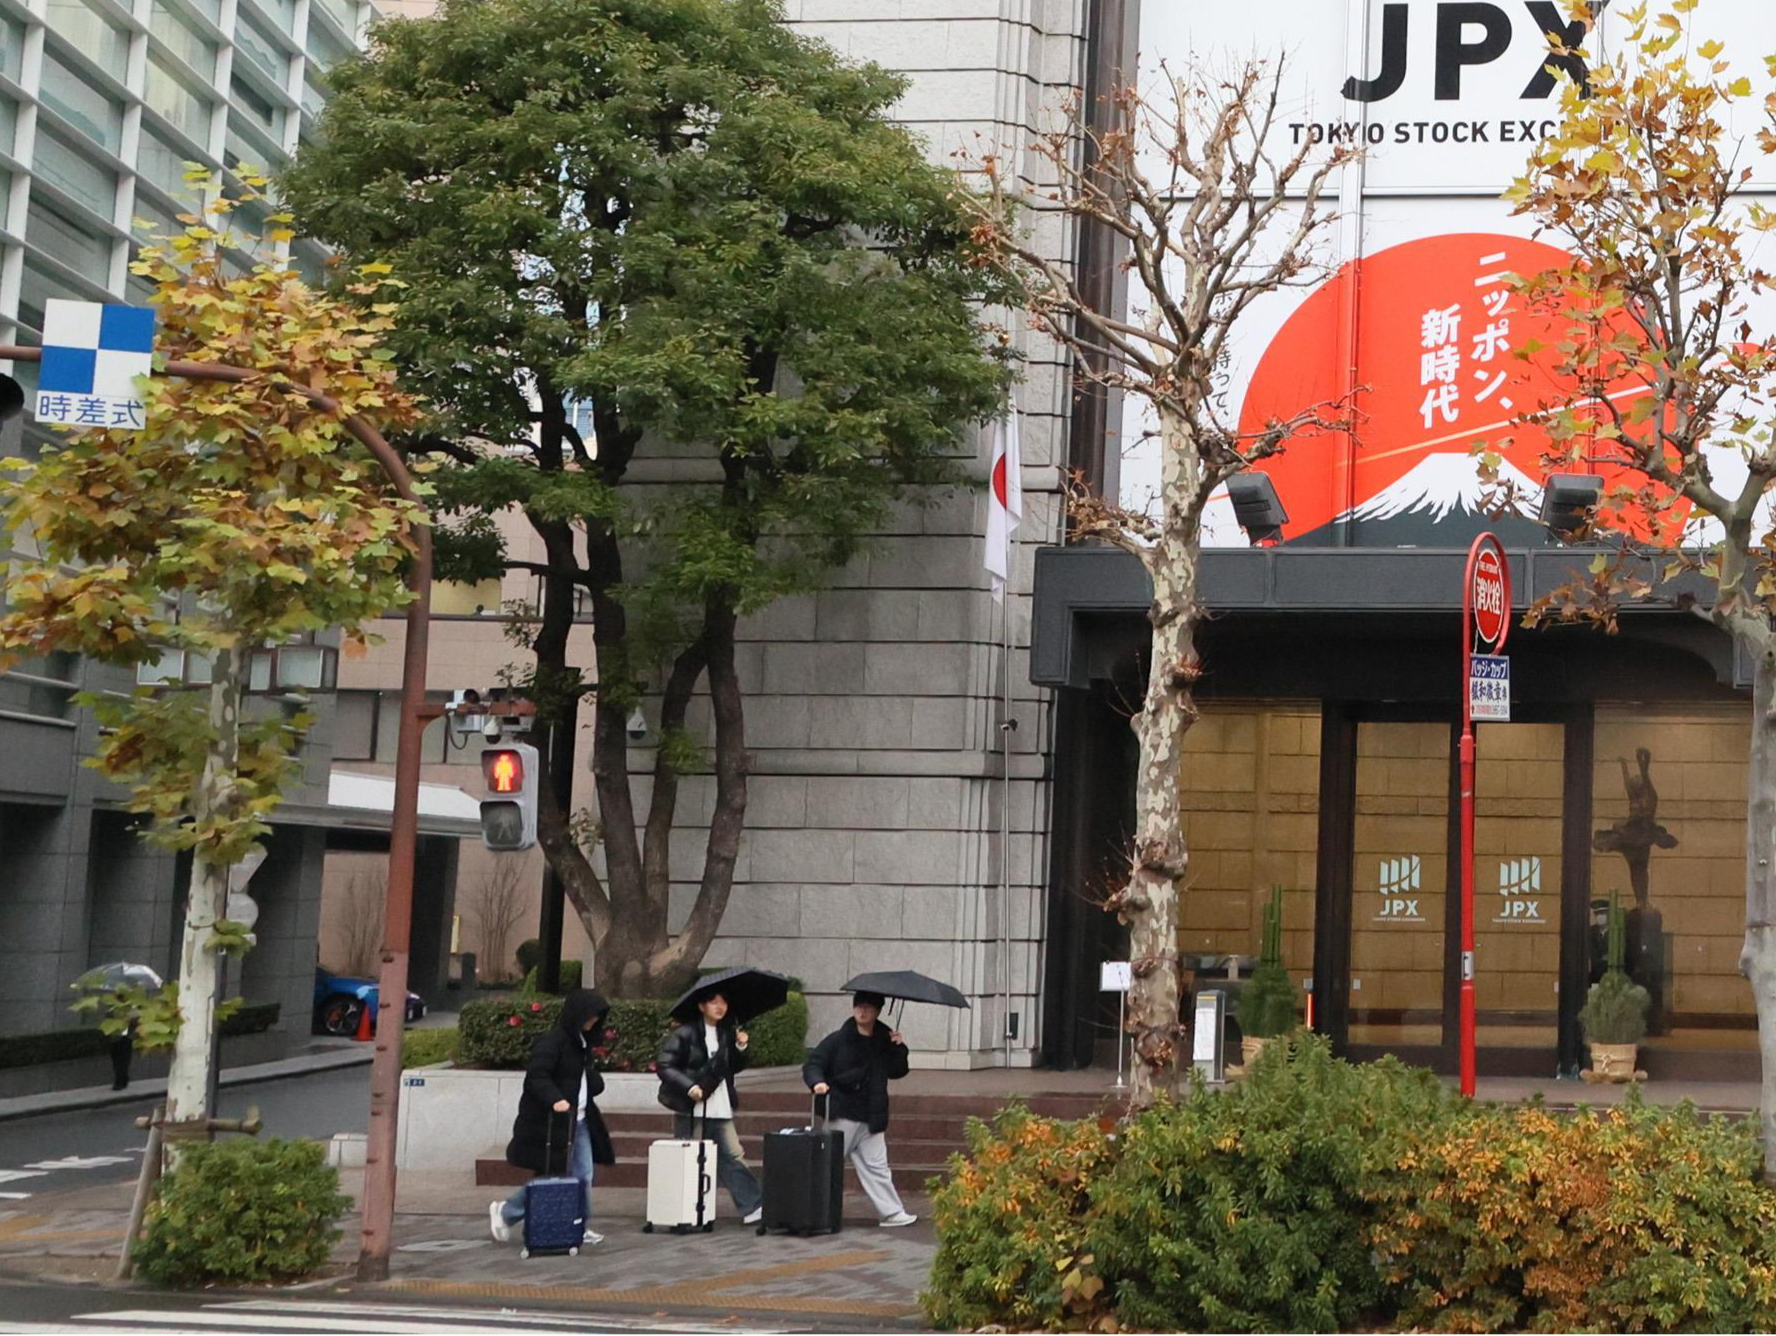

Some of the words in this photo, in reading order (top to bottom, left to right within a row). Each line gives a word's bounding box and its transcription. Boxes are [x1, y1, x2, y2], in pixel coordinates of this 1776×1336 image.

[1340, 0, 1611, 103] JPX
[1288, 121, 1385, 145] TOKYO
[1393, 120, 1490, 144] STOCK
[1470, 251, 1514, 410] ニッポン、
[1419, 302, 1462, 430] 新時代
[39, 394, 144, 427] 時差式
[1476, 575, 1502, 616] 消火栓
[1379, 899, 1419, 916] JPX
[1500, 900, 1539, 917] JPX
